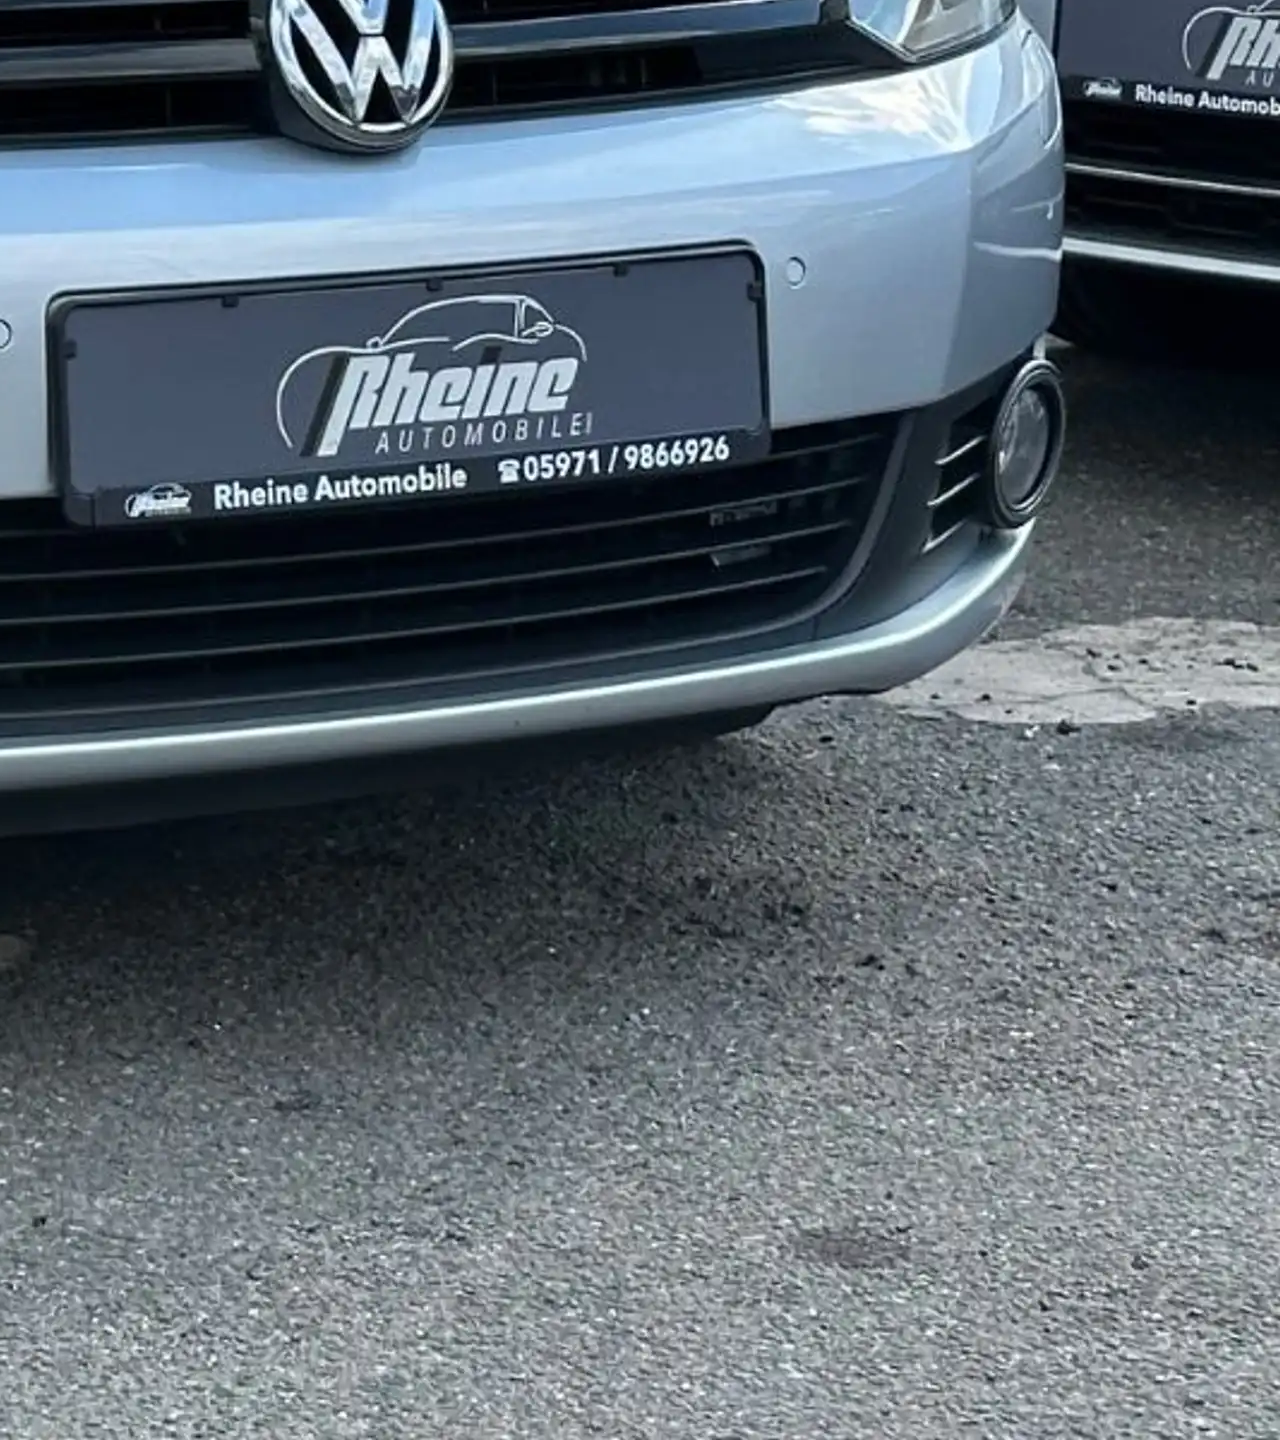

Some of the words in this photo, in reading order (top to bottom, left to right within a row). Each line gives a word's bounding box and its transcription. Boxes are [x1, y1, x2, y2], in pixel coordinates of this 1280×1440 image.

[1206, 17, 1280, 81] Rh
[1135, 83, 1195, 107] Rheine
[1198, 90, 1280, 116] Automob
[316, 352, 578, 457] Rheine
[214, 480, 307, 510] Rheine
[314, 464, 468, 501] Automobile
[523, 449, 601, 481] 05971
[608, 446, 620, 474] /
[624, 435, 730, 470] 9866926
